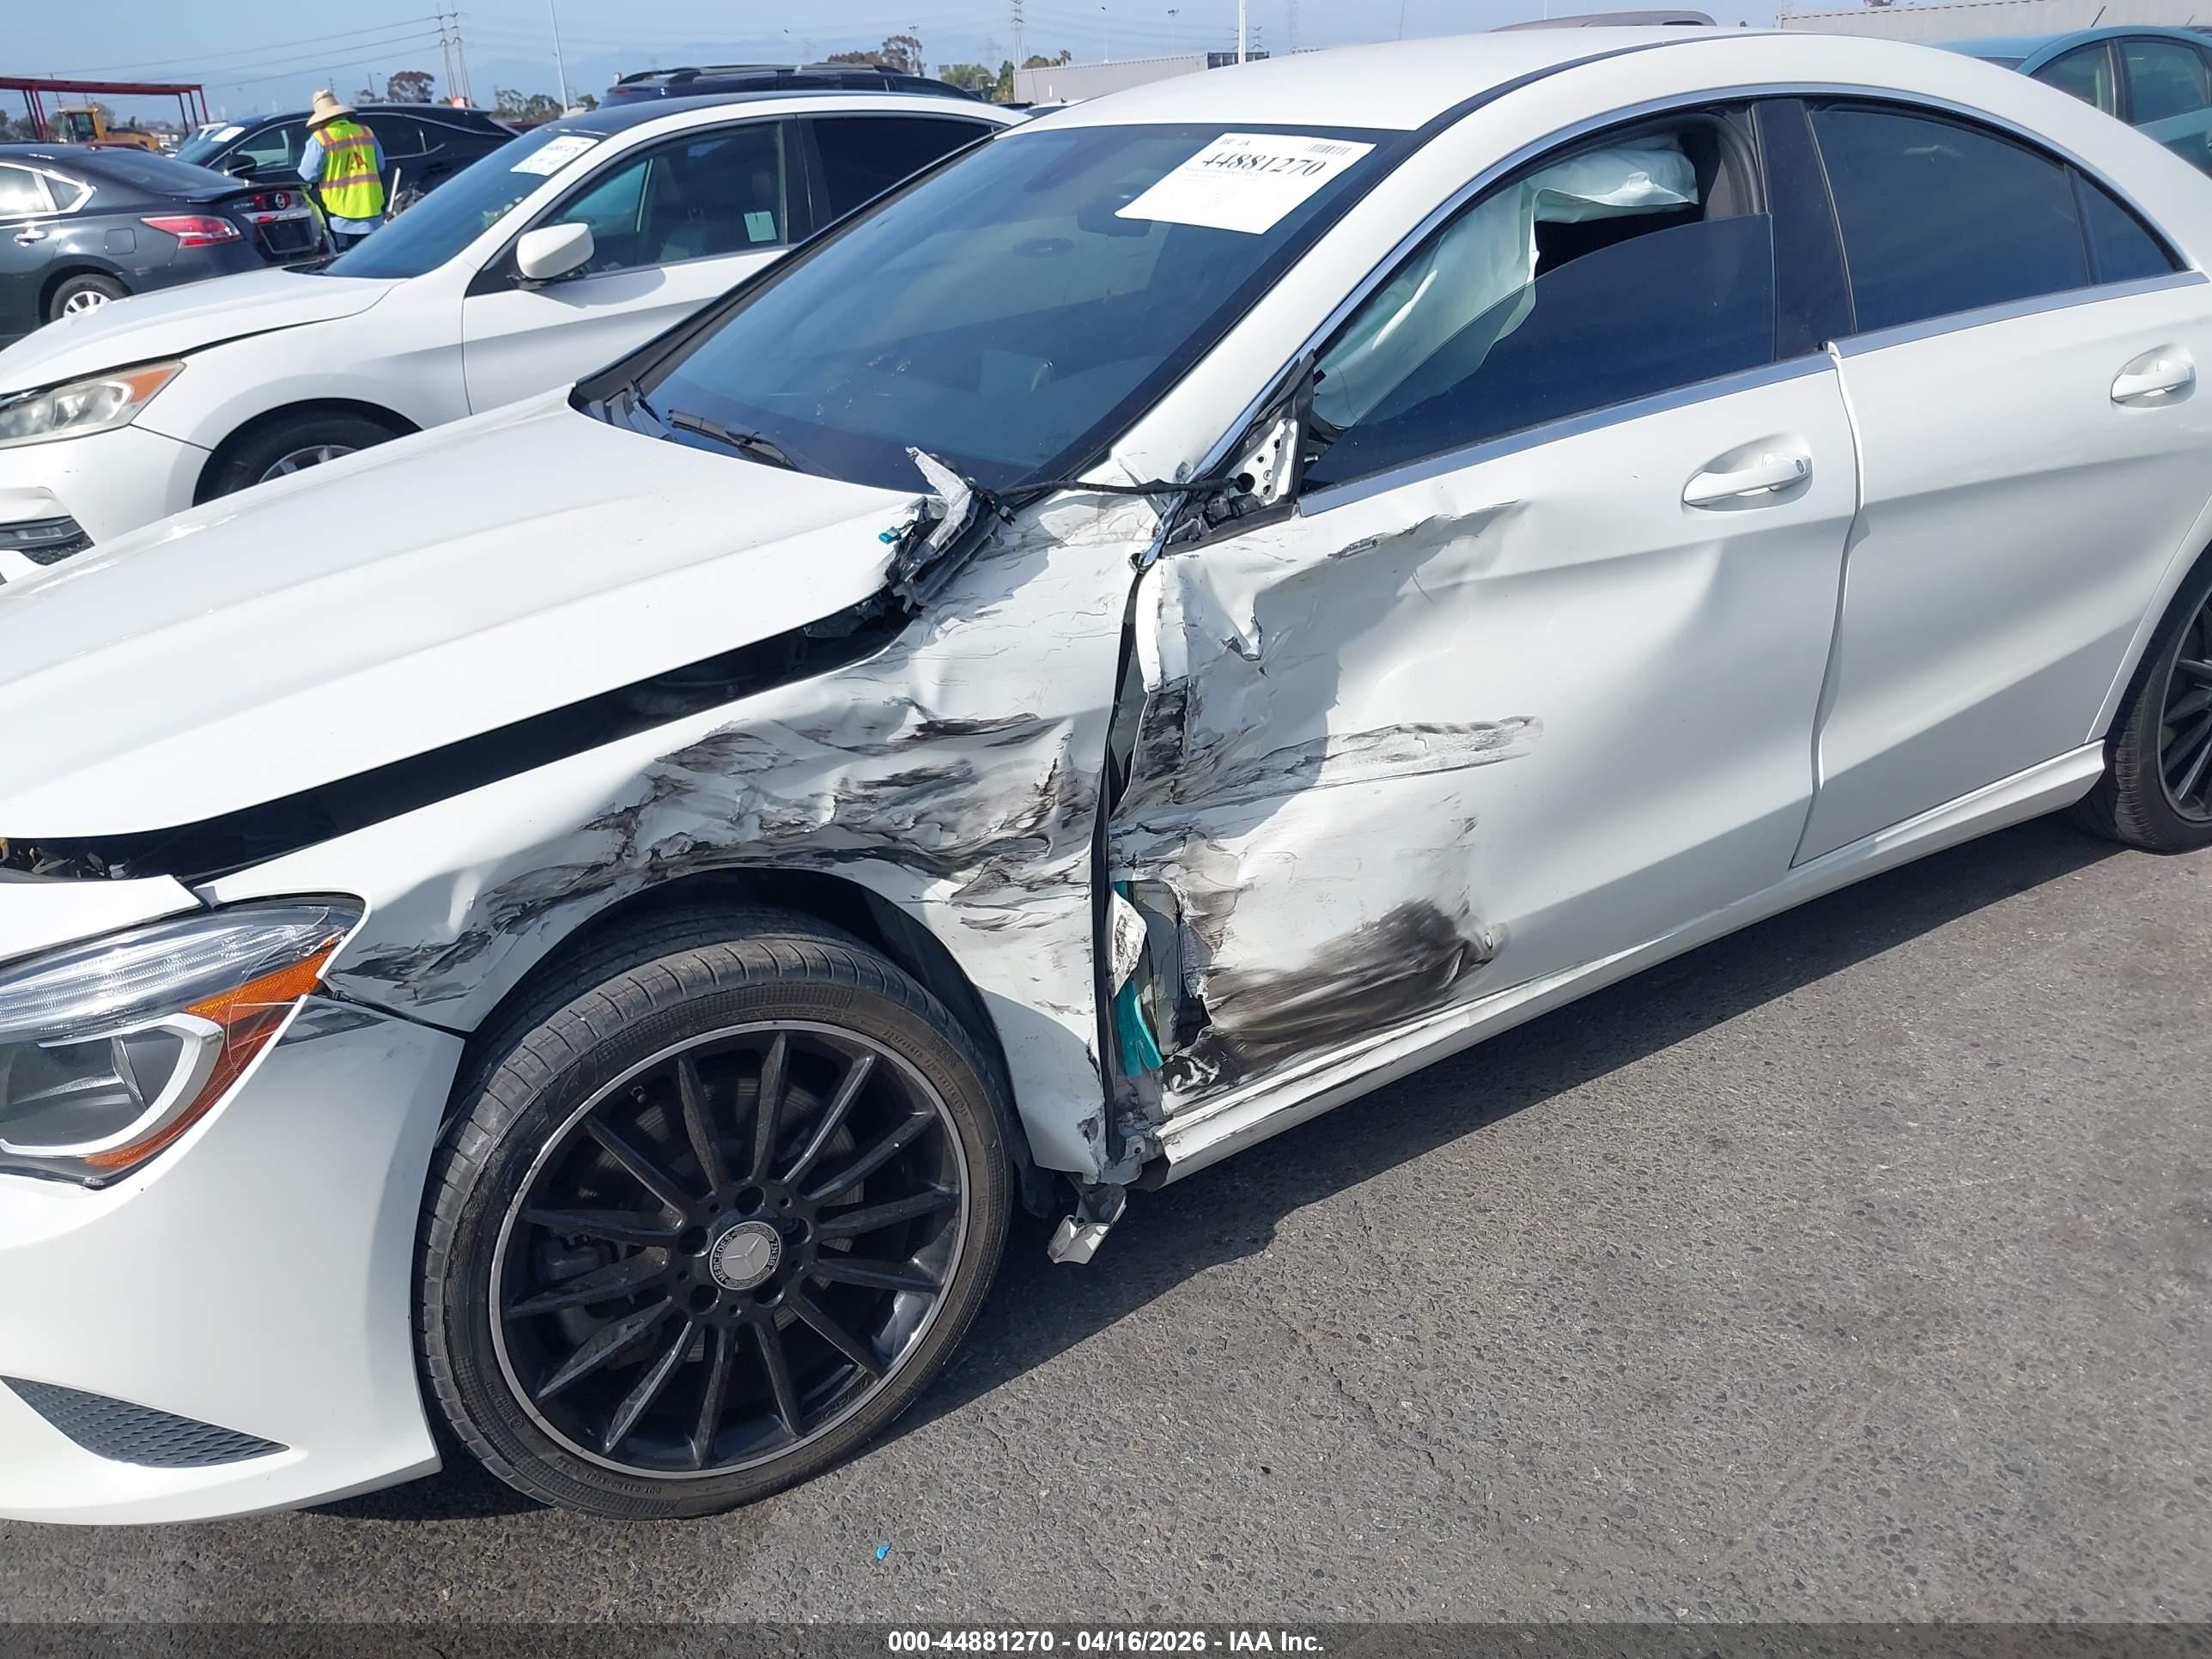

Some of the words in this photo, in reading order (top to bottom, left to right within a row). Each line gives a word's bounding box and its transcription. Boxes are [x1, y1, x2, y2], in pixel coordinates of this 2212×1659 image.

[1201, 150, 1328, 177] 44881270
[714, 1234, 733, 1281] MERCEDES
[768, 1236, 779, 1267] BENZ
